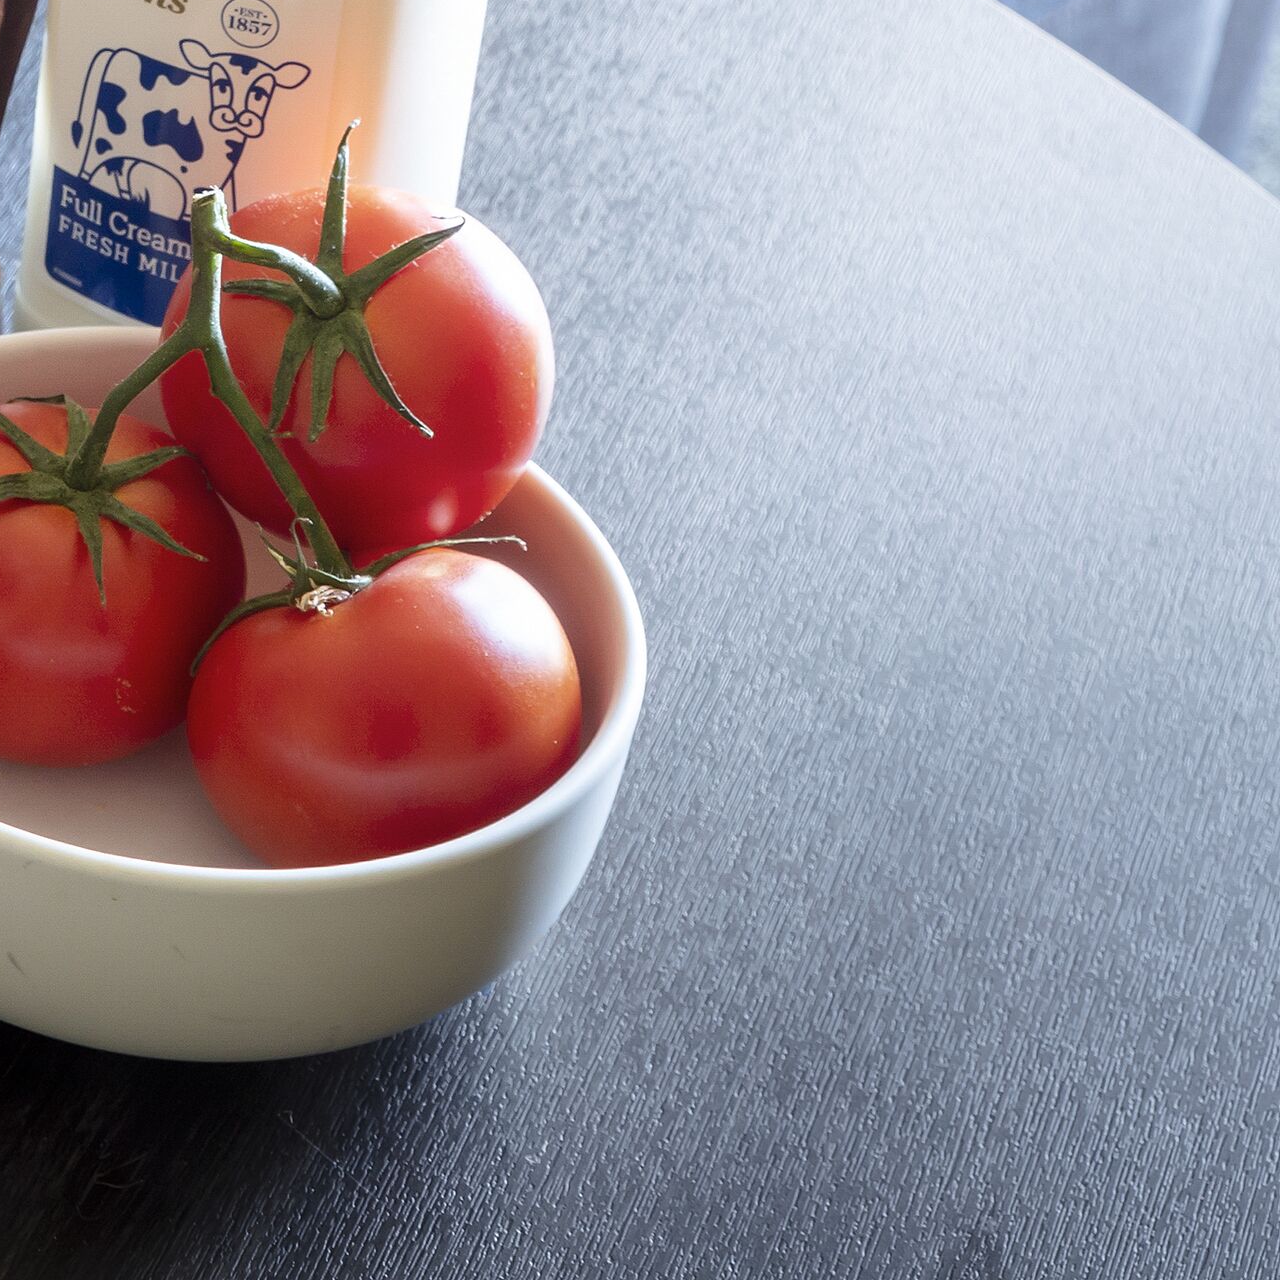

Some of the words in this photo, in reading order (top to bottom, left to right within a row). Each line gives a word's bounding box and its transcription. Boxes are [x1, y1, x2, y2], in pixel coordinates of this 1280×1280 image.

[228, 15, 273, 36] 1857
[57, 214, 130, 265] FRESH
[137, 253, 181, 283] MIL
[59, 184, 103, 226] Full
[108, 211, 190, 260] Cream
